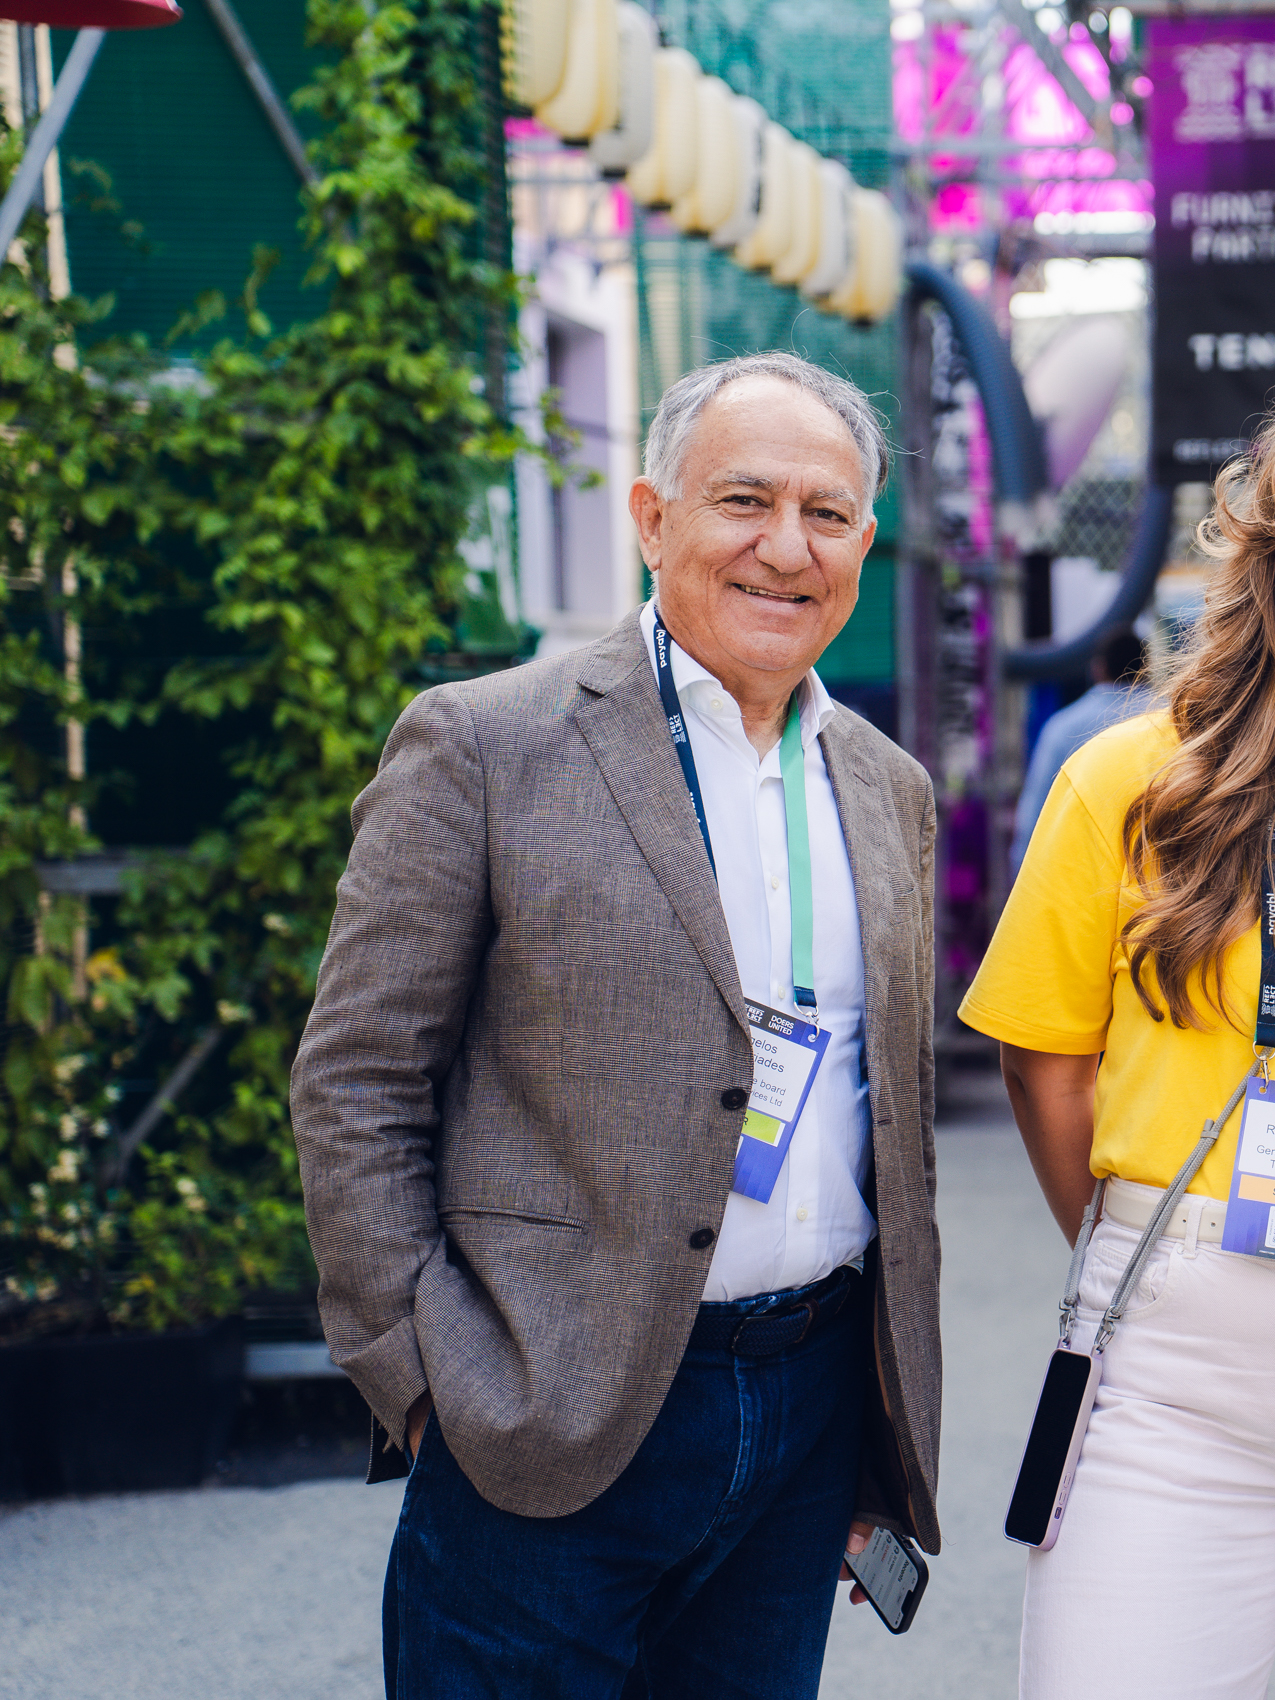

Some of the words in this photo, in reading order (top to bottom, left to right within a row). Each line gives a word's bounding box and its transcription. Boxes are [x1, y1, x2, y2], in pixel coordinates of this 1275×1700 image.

[768, 1021, 792, 1036] UNITED
[771, 1015, 795, 1029] DOERS
[760, 1079, 786, 1096] board
[770, 1096, 783, 1107] Ltd
